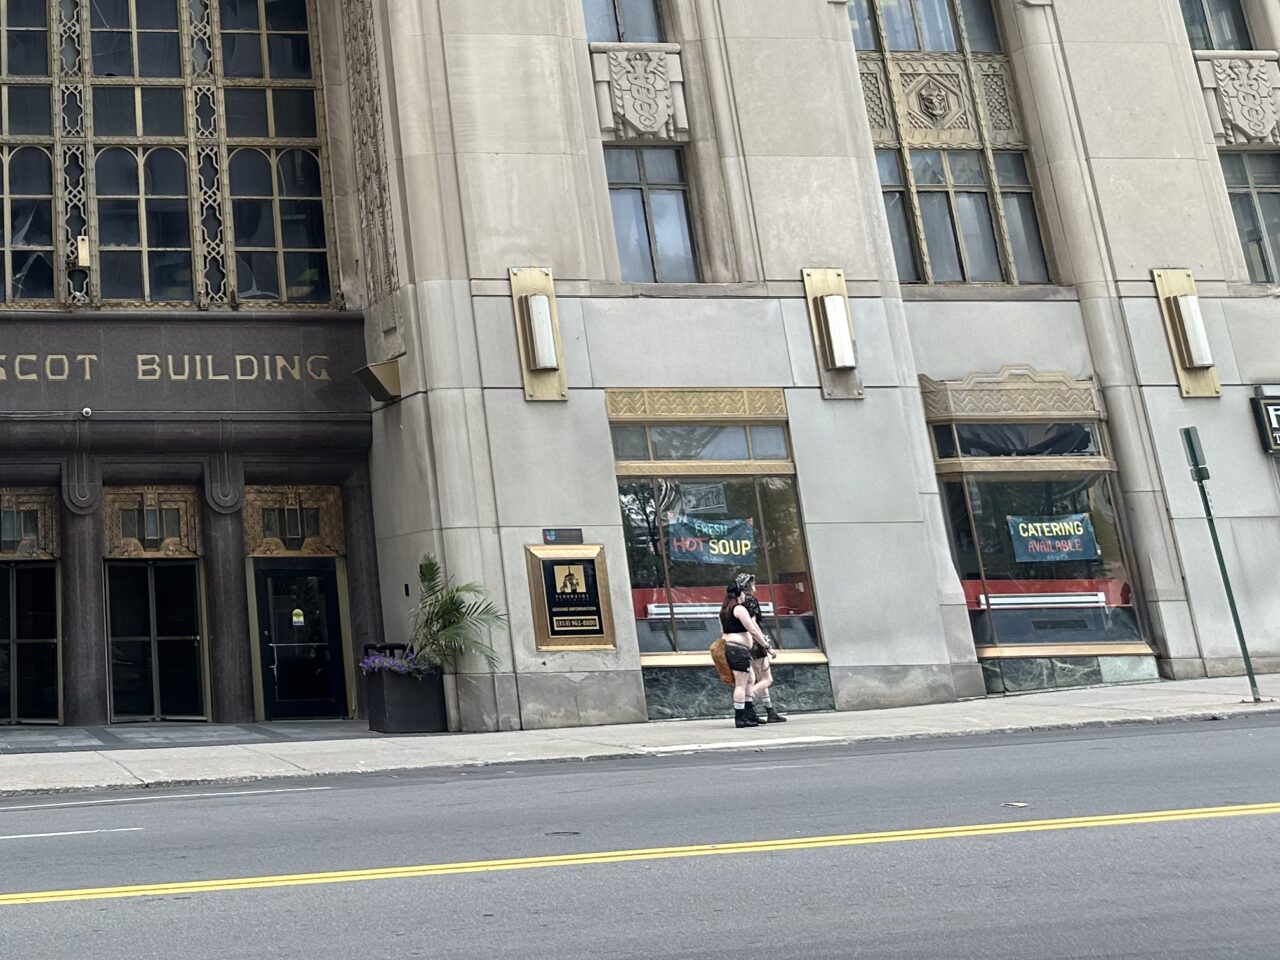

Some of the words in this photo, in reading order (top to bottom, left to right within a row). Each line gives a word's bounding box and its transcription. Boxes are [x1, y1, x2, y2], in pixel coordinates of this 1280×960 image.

[136, 353, 332, 381] BUILDING
[695, 523, 728, 536] FRESH
[1018, 521, 1084, 537] CATERING
[673, 537, 707, 552] HOT
[708, 539, 751, 555] SOUP
[1028, 539, 1083, 553] AVAILABLE
